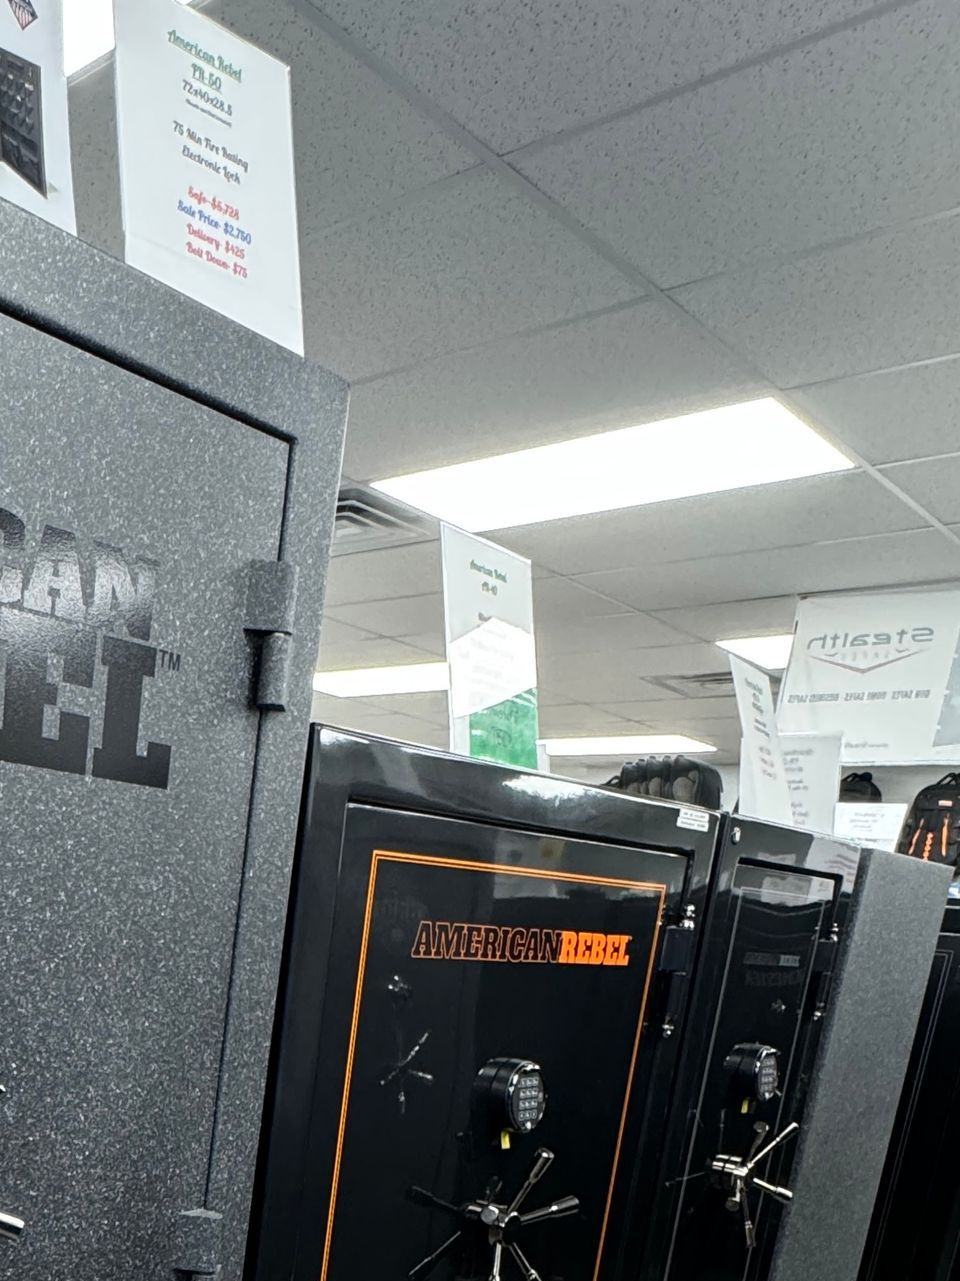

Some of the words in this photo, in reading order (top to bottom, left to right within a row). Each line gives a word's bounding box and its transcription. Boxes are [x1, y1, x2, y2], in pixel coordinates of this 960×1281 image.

[167, 29, 215, 67] American
[217, 55, 242, 82] Rebel
[182, 145, 221, 174] Electronic
[223, 166, 241, 185] Lock
[411, 920, 563, 963] AMERICAN
[558, 931, 632, 966] REBEL
